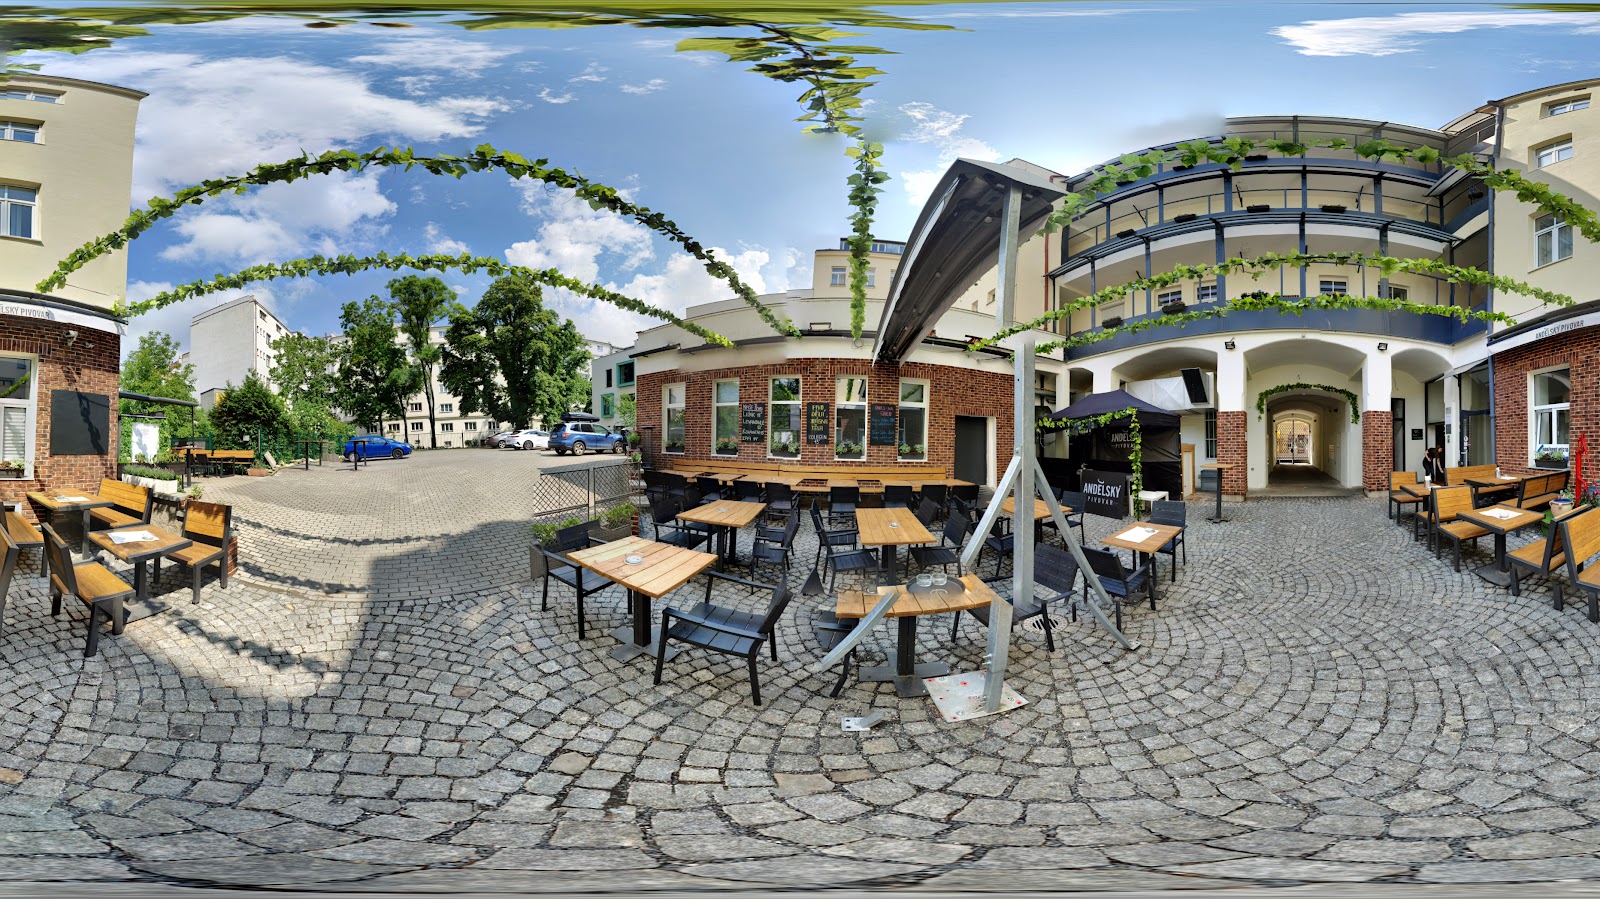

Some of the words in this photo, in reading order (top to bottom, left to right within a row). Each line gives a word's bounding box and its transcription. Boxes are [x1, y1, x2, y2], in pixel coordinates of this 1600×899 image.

[20, 306, 50, 319] PIVOVAR
[1560, 320, 1584, 332] PIVOVAR
[1083, 478, 1122, 498] ANDĚLSKÝ
[1087, 495, 1114, 506] PIVOVAR
